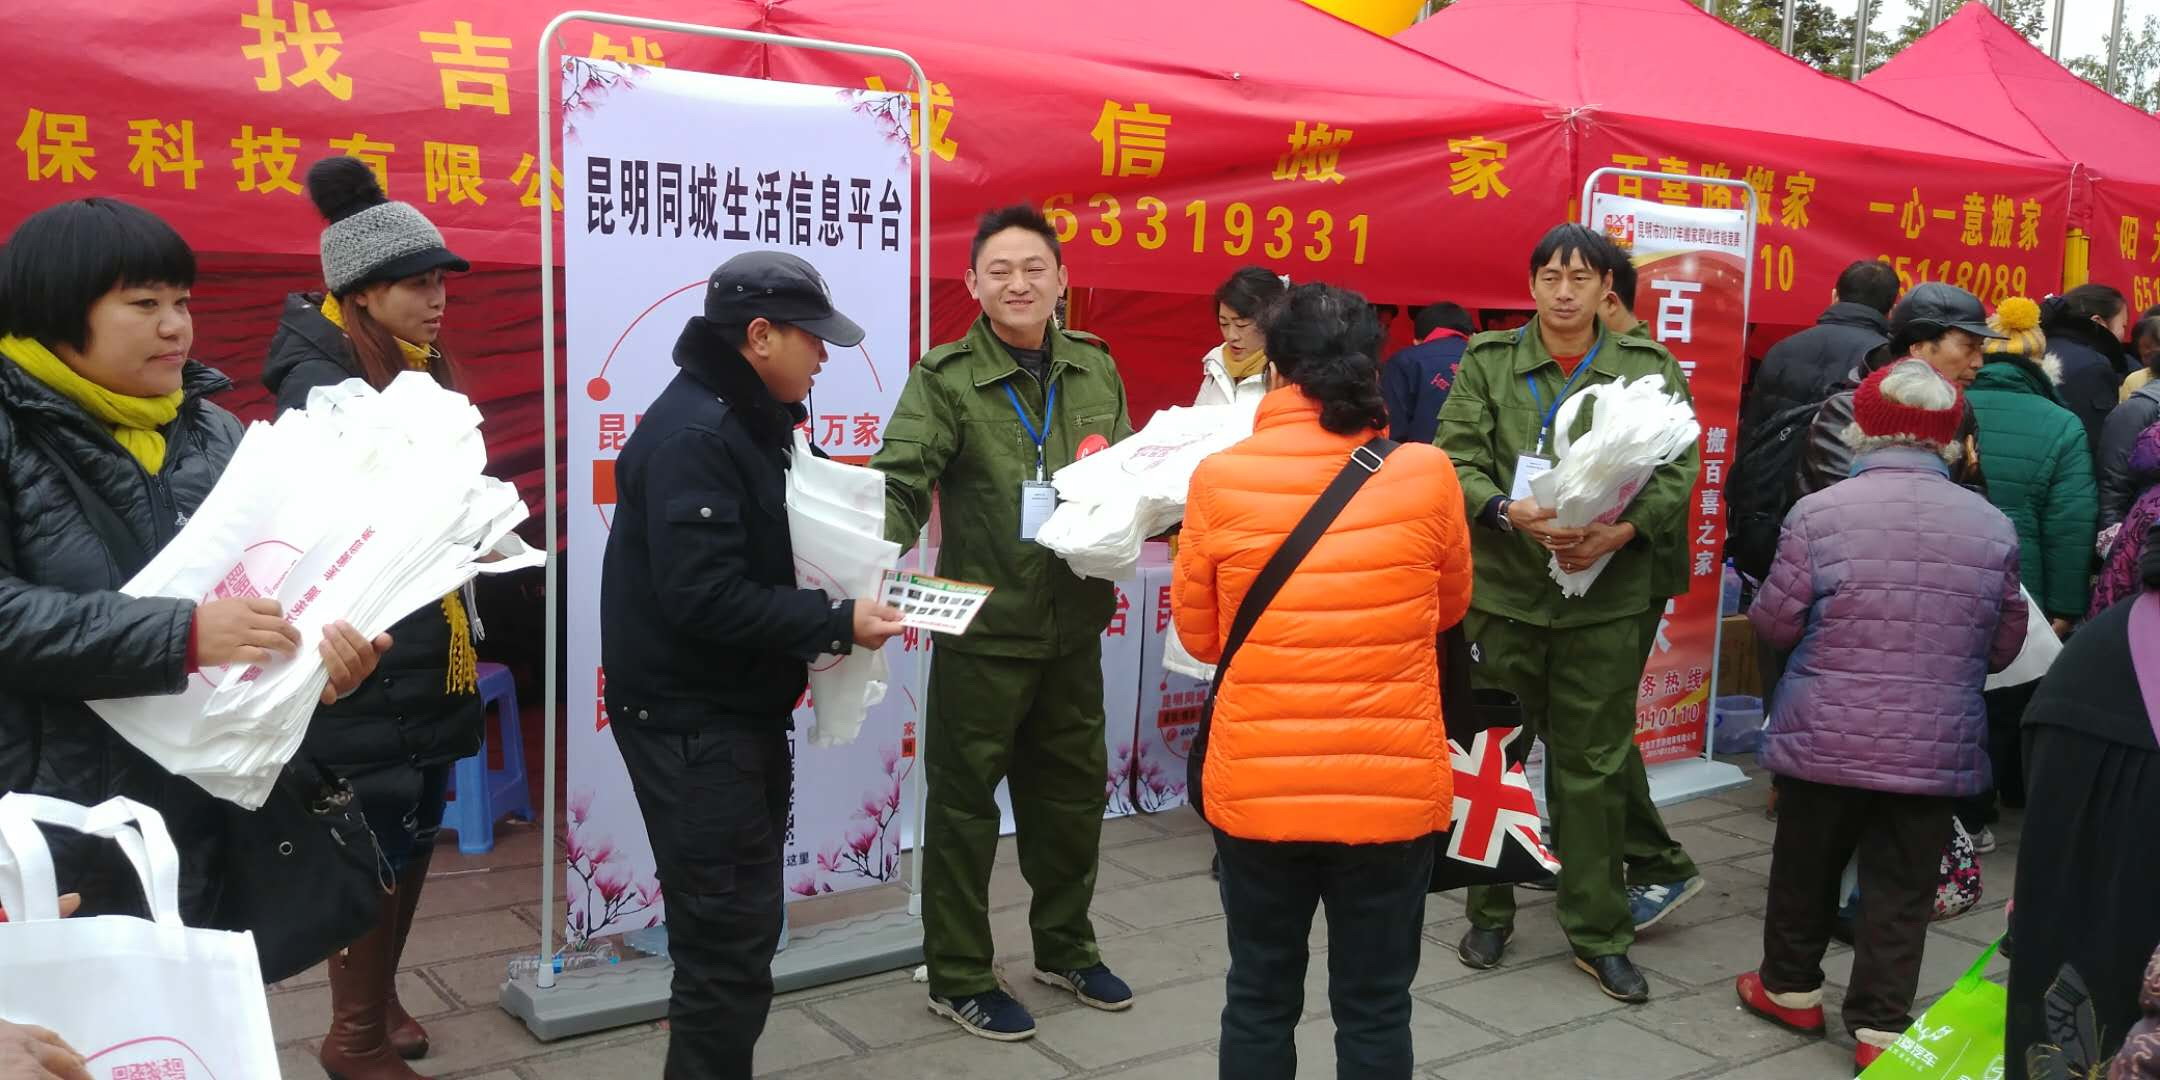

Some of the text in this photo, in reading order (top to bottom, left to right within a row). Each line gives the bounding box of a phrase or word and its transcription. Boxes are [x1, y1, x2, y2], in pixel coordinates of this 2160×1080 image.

[587, 156, 903, 252] 昆明同城生活信息平台
[1043, 194, 1370, 265] 63319331
[1869, 187, 2042, 251] 一心一意搬家
[1878, 254, 2027, 306] 5118089
[599, 413, 645, 451] 昆
[1694, 427, 1728, 576] 搬百喜之家
